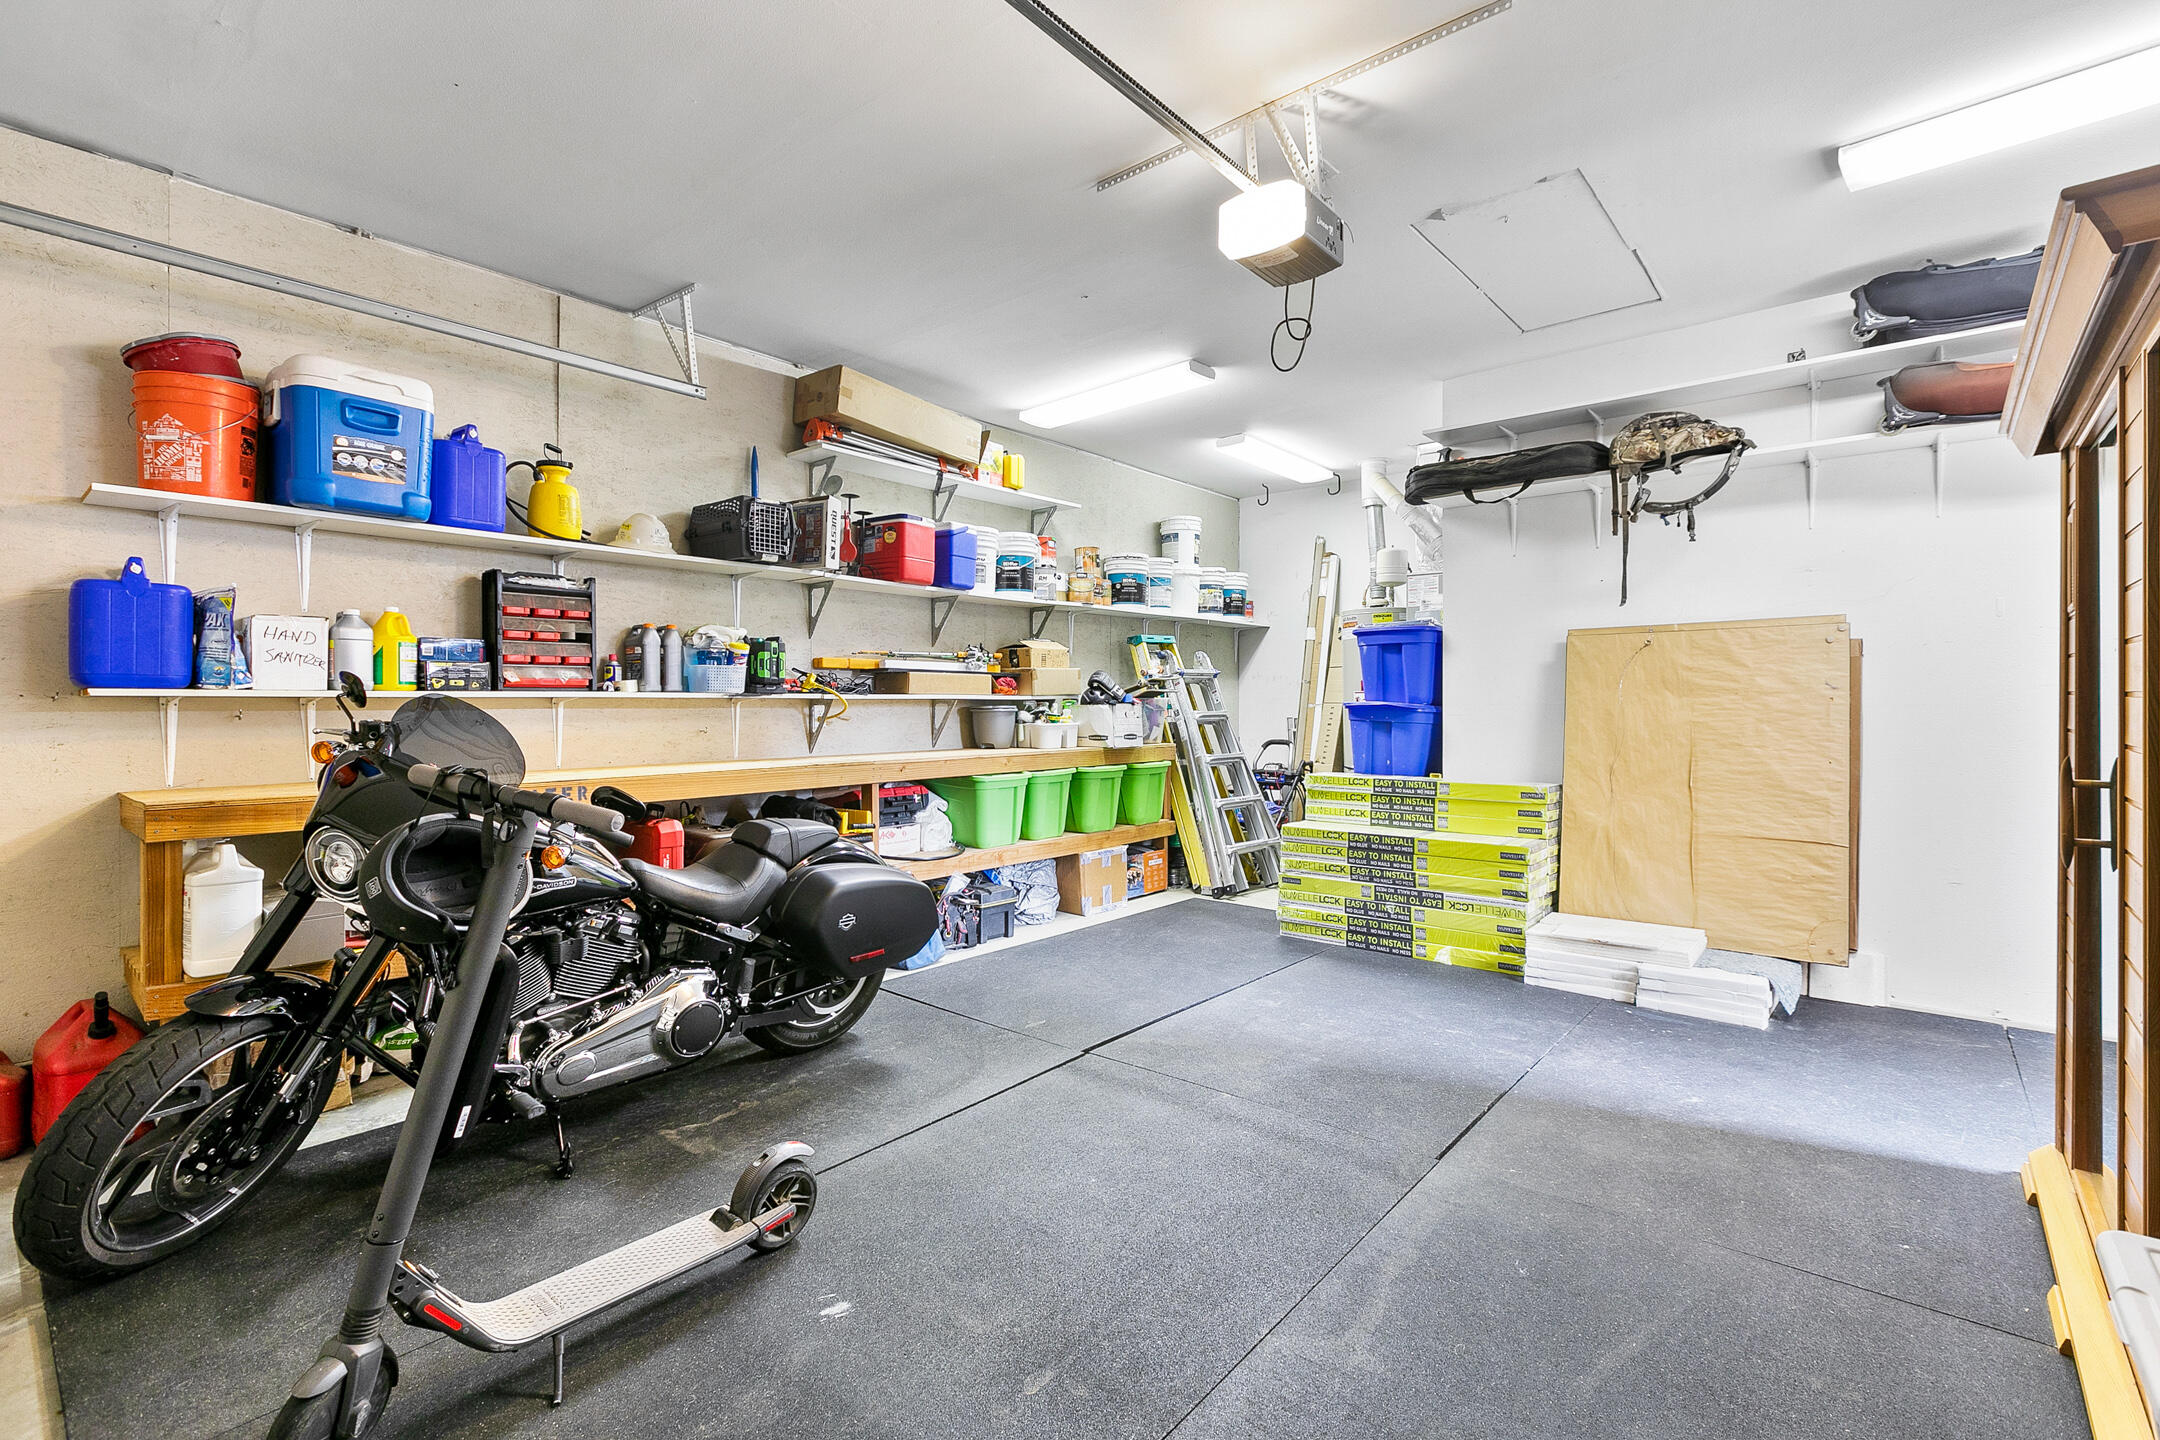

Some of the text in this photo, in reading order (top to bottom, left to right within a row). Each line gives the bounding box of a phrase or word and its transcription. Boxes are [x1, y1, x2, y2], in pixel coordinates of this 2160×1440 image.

[154, 441, 184, 467] HOME
[830, 510, 838, 545] QUEST
[263, 625, 317, 645] HAND
[264, 648, 327, 671] SANITIZER
[1403, 797, 1433, 805] INSTALL
[1403, 813, 1432, 822] INSTALL
[1349, 833, 1367, 842] EASY
[1382, 836, 1412, 846] INSTALL
[1348, 850, 1366, 858] EASY
[1381, 853, 1412, 862] INSTALL
[1352, 867, 1369, 875] EASY
[1383, 870, 1413, 880] INSTALL
[1346, 899, 1364, 908] EASY
[1375, 892, 1441, 907] EASY TO INSTALL
[1349, 917, 1366, 926] EASY
[1380, 921, 1410, 932] INSTALL
[1347, 932, 1411, 949] EASY TO INSTALL
